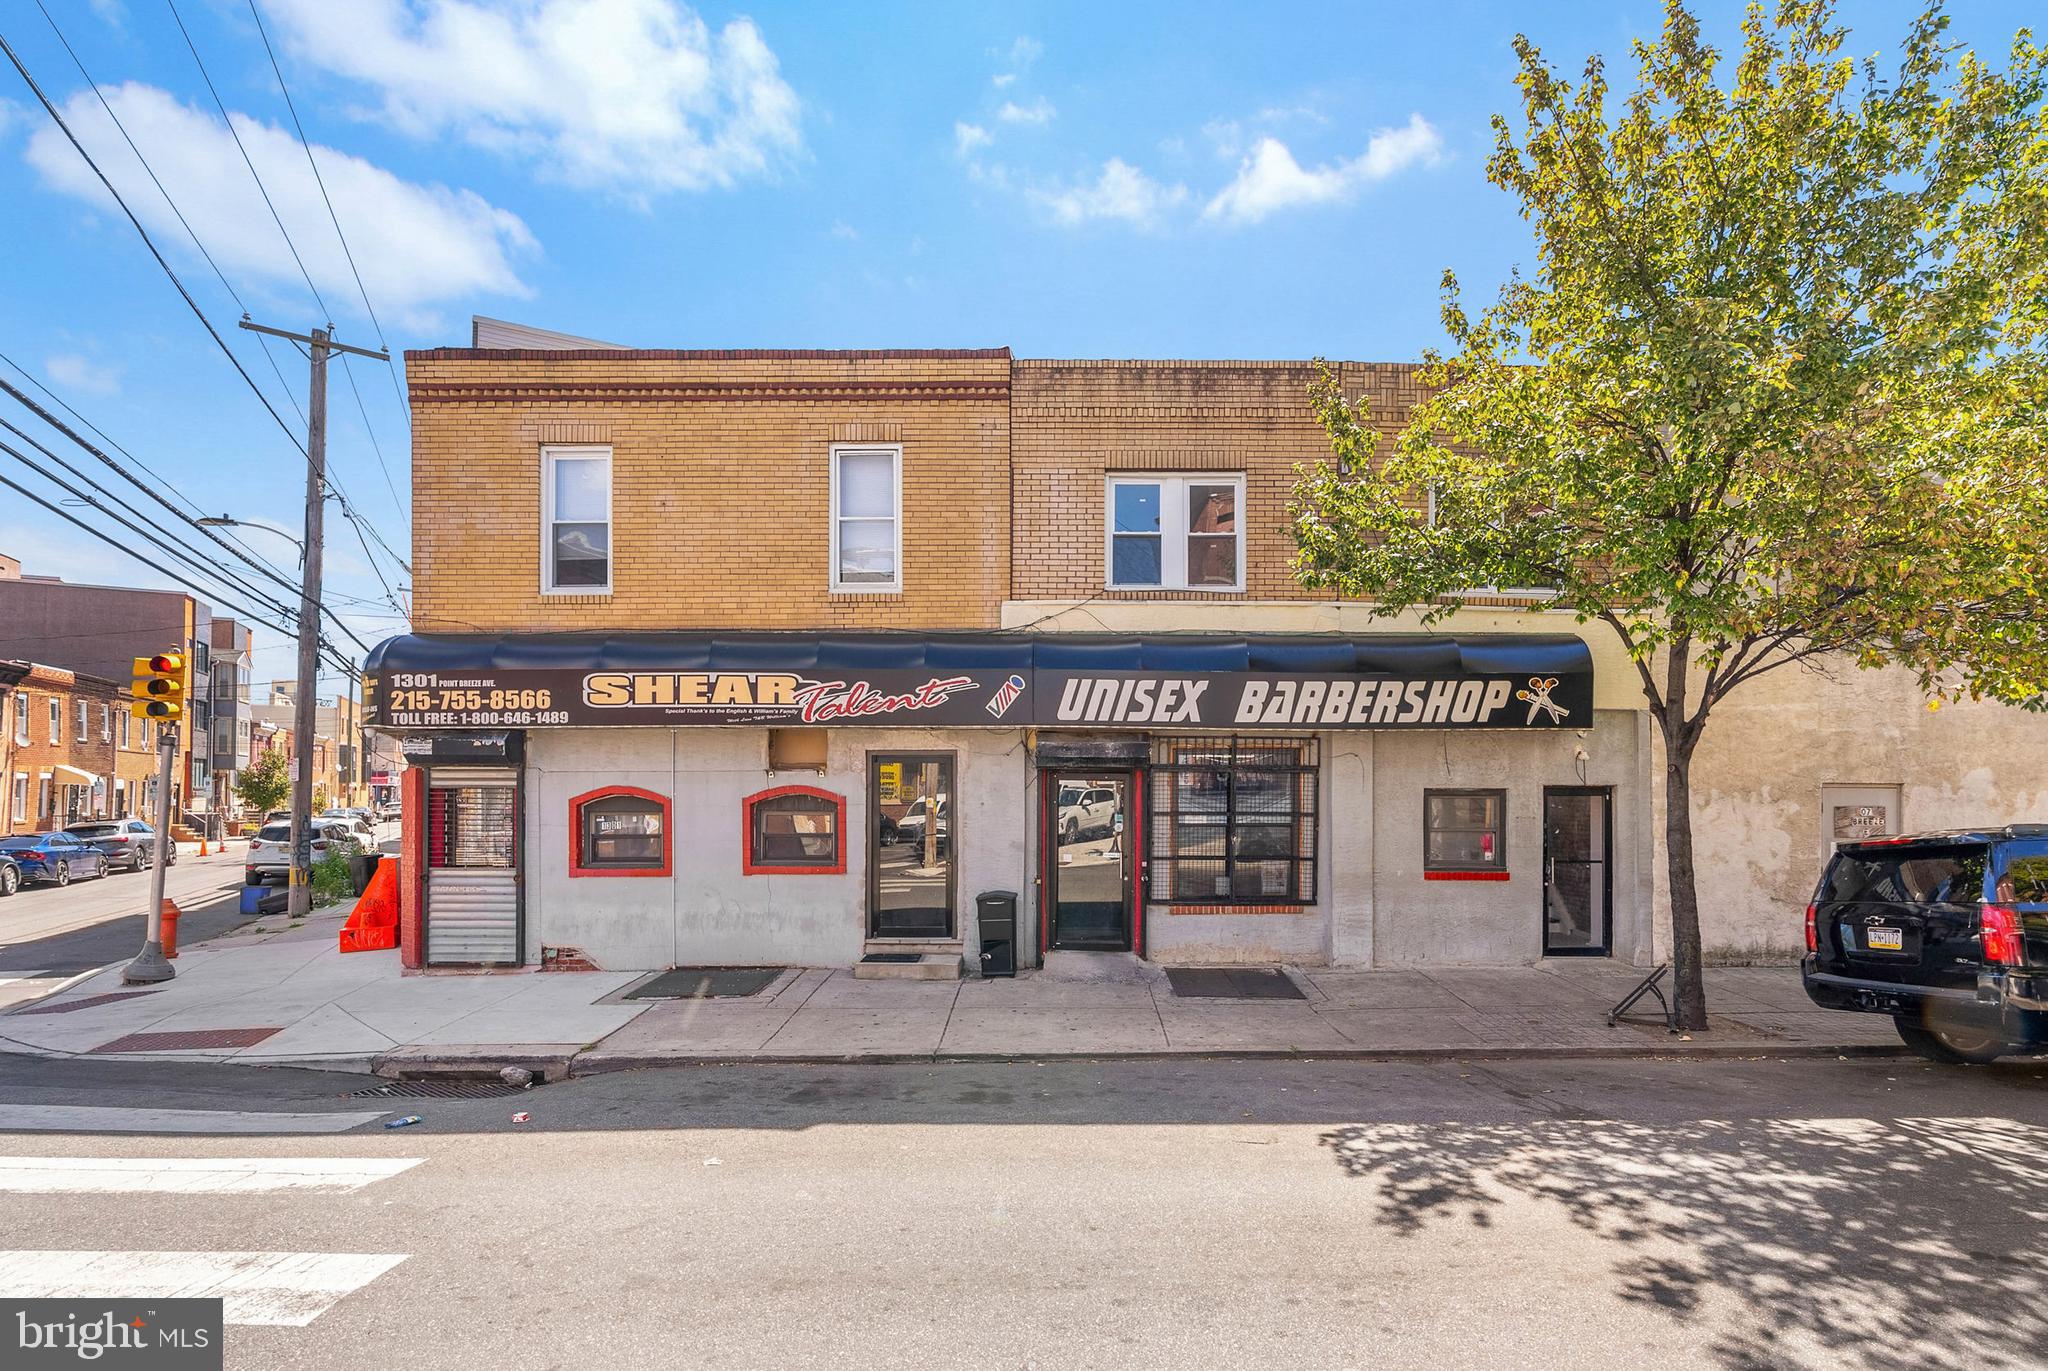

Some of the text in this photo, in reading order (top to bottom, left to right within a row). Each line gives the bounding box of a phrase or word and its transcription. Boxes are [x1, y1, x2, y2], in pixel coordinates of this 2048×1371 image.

[391, 674, 437, 688] 1301
[483, 679, 496, 687] AVE.
[390, 689, 551, 710] 215-755-8566
[585, 673, 974, 723] SHEAR Talent
[1057, 678, 1513, 723] UNISEX BARBERSHOP
[391, 712, 424, 725] TOLL
[424, 712, 458, 725] FREE:
[460, 711, 569, 725] 1-800-646-1489
